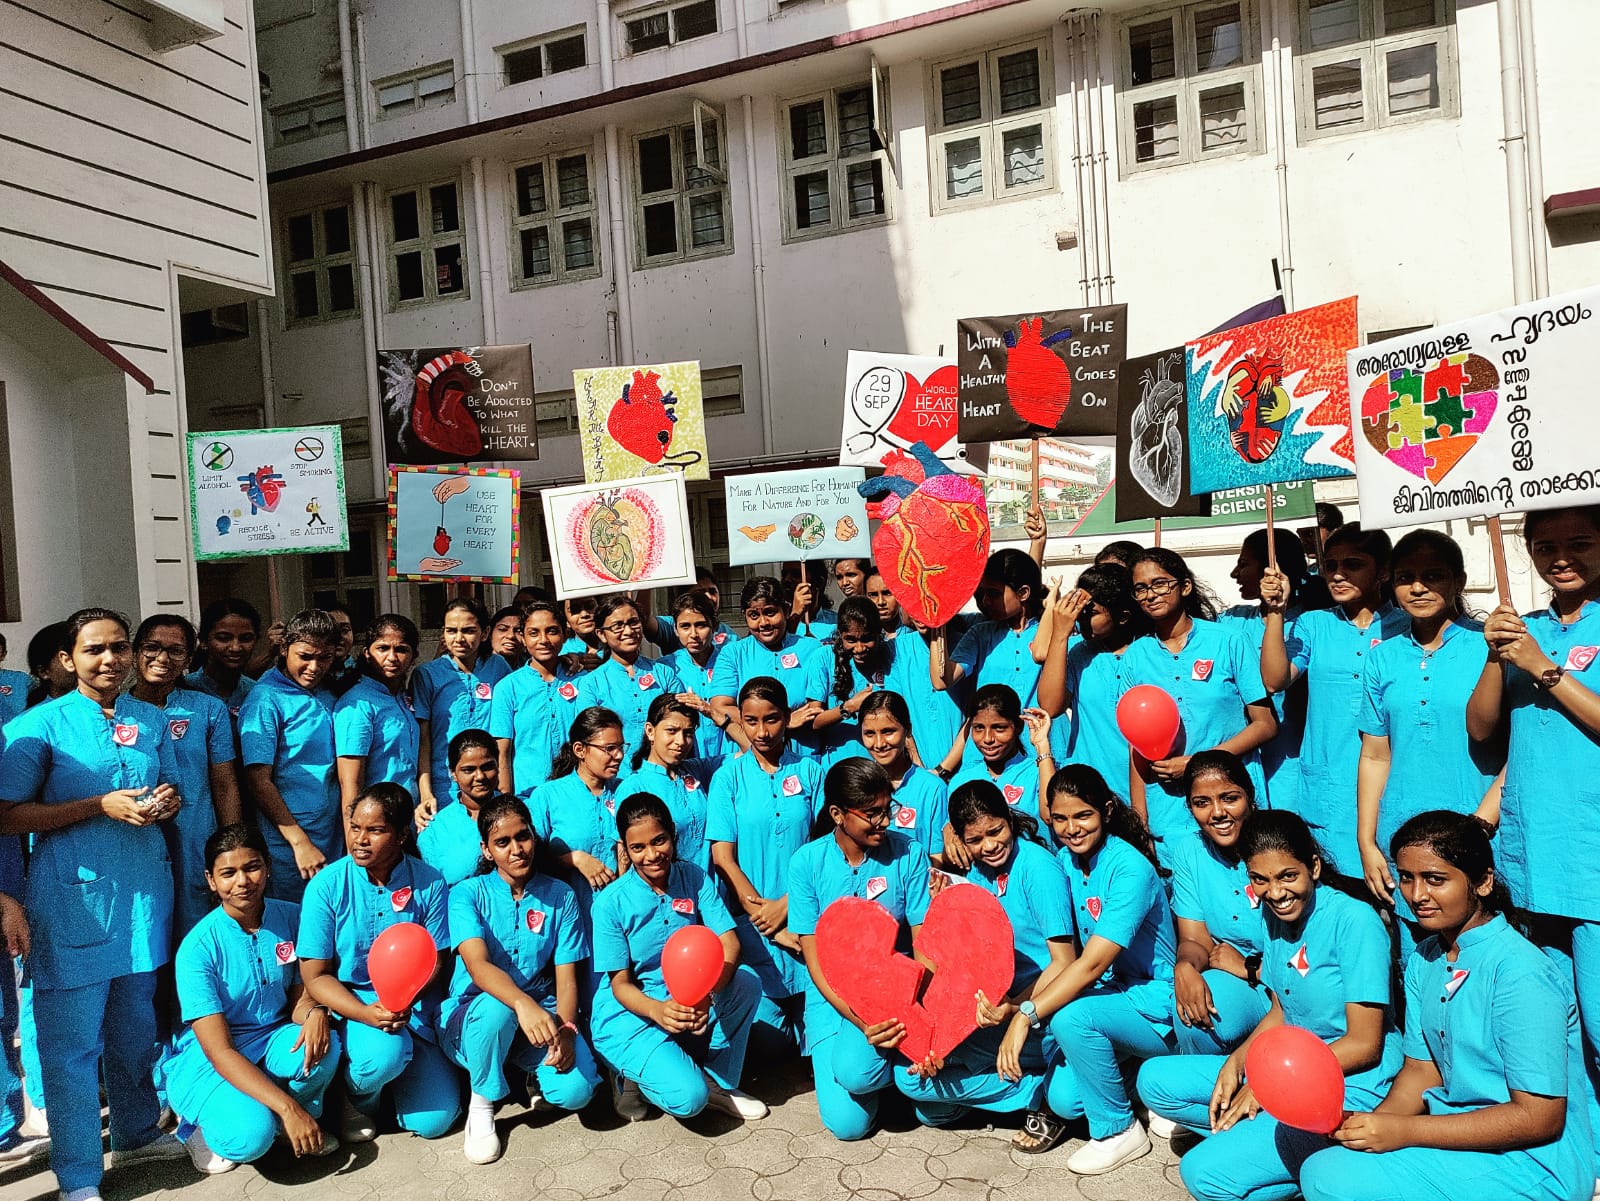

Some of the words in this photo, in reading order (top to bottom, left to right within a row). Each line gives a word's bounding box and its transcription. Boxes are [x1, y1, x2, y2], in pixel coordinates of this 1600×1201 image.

[1079, 313, 1115, 333] THE
[966, 331, 1002, 352] WITH
[1356, 332, 1473, 378] ആരോഗ്യമുള്ള
[1490, 302, 1592, 345] ഹൃദയം
[1070, 340, 1111, 358] BEAT
[978, 354, 992, 371] A
[960, 373, 1007, 390] HEALTHY
[1075, 366, 1117, 382] GOES
[480, 378, 519, 392] DON'T
[869, 374, 891, 393] 29
[925, 385, 958, 395] WORLD
[467, 396, 480, 407] BE
[484, 394, 533, 407] ADDICTED
[864, 394, 890, 410] SEP
[915, 396, 958, 411] HEART
[1081, 391, 1108, 408] ON
[474, 409, 487, 419] TO
[490, 410, 519, 419] WHAT
[962, 400, 1002, 418] HEART
[480, 424, 502, 434] KILL
[507, 423, 527, 433] THE
[917, 413, 953, 429] DAY
[489, 435, 529, 450] HEART
[299, 468, 333, 477] SMOKING
[198, 482, 232, 490] ALCOHOL
[729, 485, 752, 498] MAKE
[755, 484, 762, 496] A
[764, 483, 810, 496] DIFFERENCE
[811, 479, 826, 493] FOR
[828, 477, 864, 491] HUMANIT
[476, 491, 496, 500] USE
[742, 500, 757, 512] FOR
[762, 499, 793, 511] NATURE
[795, 497, 812, 507] AND
[816, 494, 830, 506] FOR
[833, 491, 850, 505] YOU
[465, 503, 499, 514] HEART
[475, 515, 493, 524] FOR
[238, 525, 269, 534] REDUCE
[290, 528, 301, 537] BE
[304, 526, 334, 536] ACTIVE
[466, 527, 497, 536] EVERY
[463, 540, 495, 550] HEART
